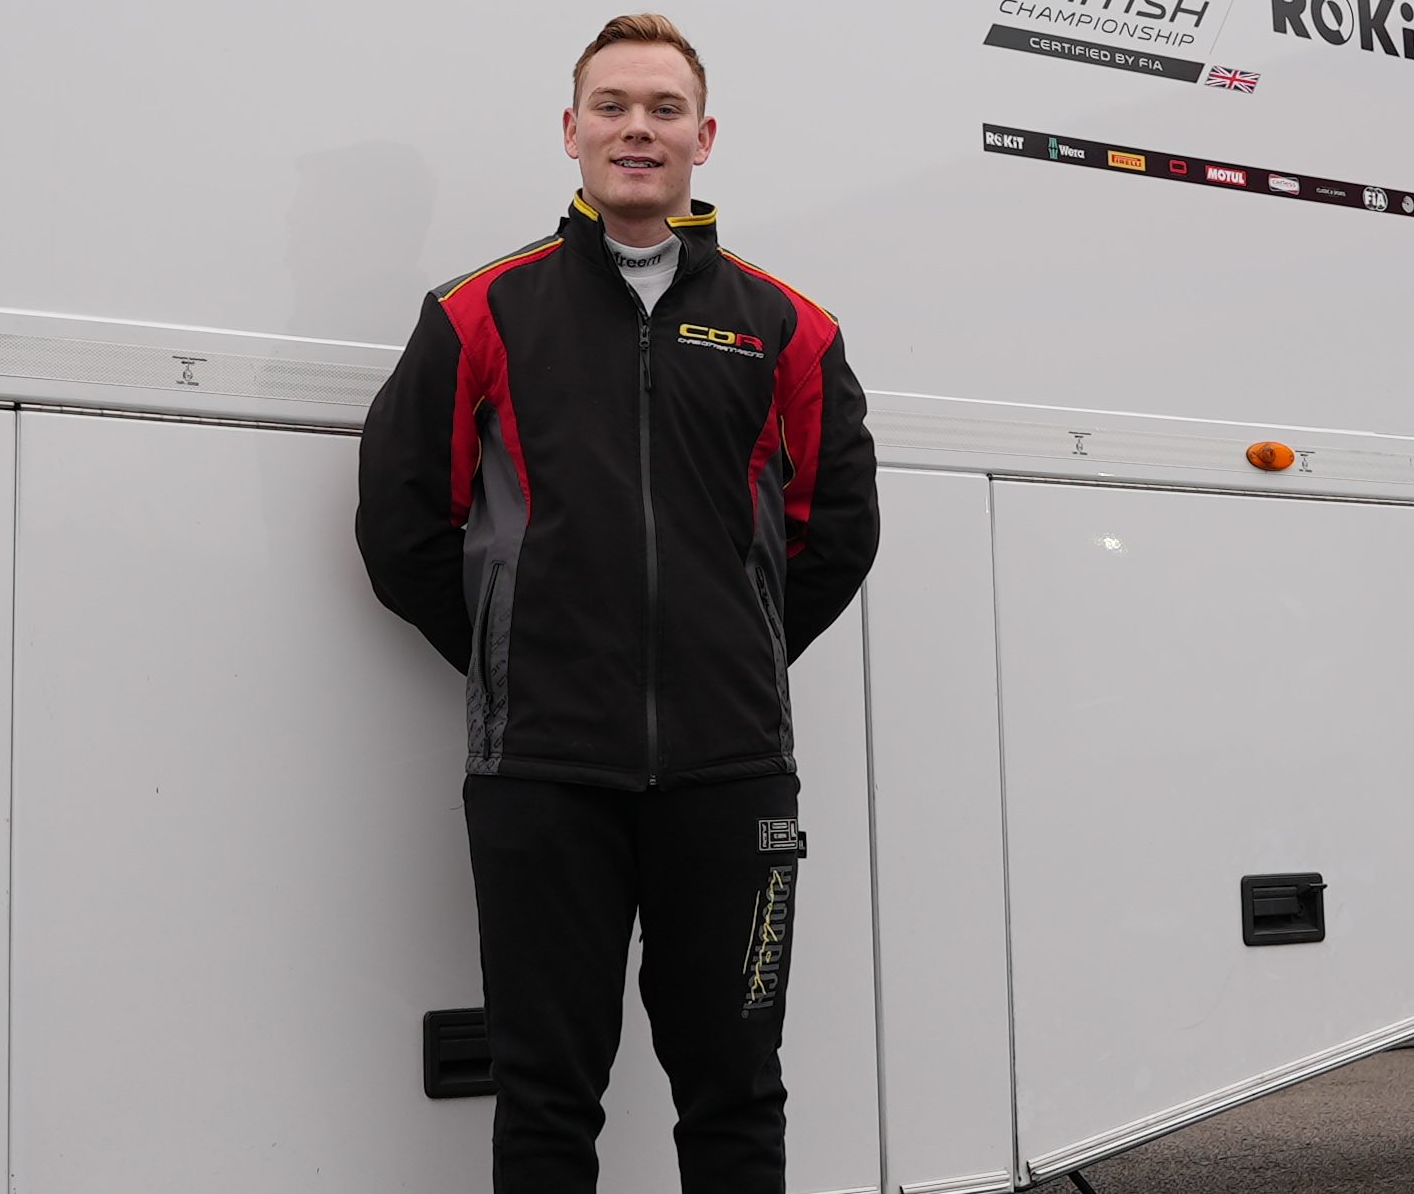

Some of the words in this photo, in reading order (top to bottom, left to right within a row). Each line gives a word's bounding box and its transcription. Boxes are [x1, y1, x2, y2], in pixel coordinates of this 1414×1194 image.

[1028, 36, 1111, 62] CERTIFIED
[1115, 53, 1135, 67] BY
[1138, 57, 1164, 72] FIA
[1058, 143, 1086, 159] Wera
[1206, 167, 1245, 184] MOTUL
[614, 251, 662, 268] freem
[679, 323, 764, 352] CDR
